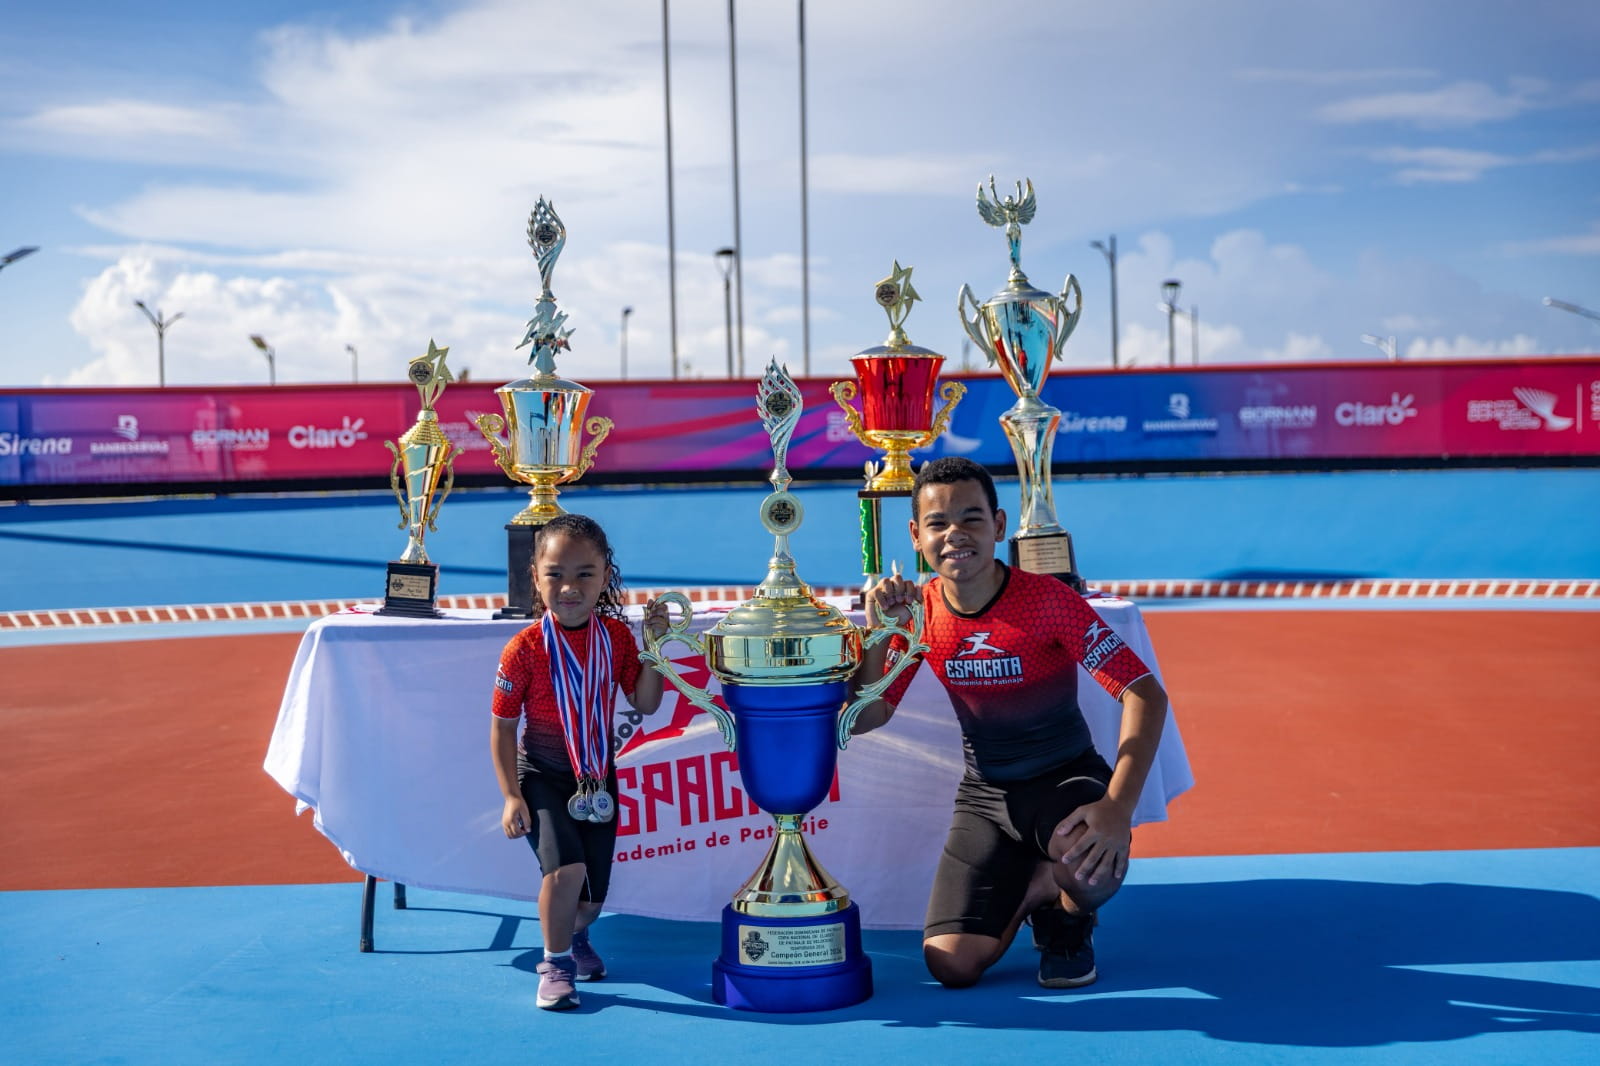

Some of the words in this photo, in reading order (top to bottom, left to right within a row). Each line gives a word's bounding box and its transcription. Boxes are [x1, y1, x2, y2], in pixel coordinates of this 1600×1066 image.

[1059, 412, 1127, 433] Sirena
[1335, 402, 1405, 426] Claro
[0, 433, 73, 455] Sirena
[288, 425, 356, 448] Claro
[945, 656, 1022, 678] ESPACATA
[611, 838, 696, 864] ademia
[705, 831, 731, 849] de
[740, 816, 829, 843] Pataje
[803, 949, 829, 958] General
